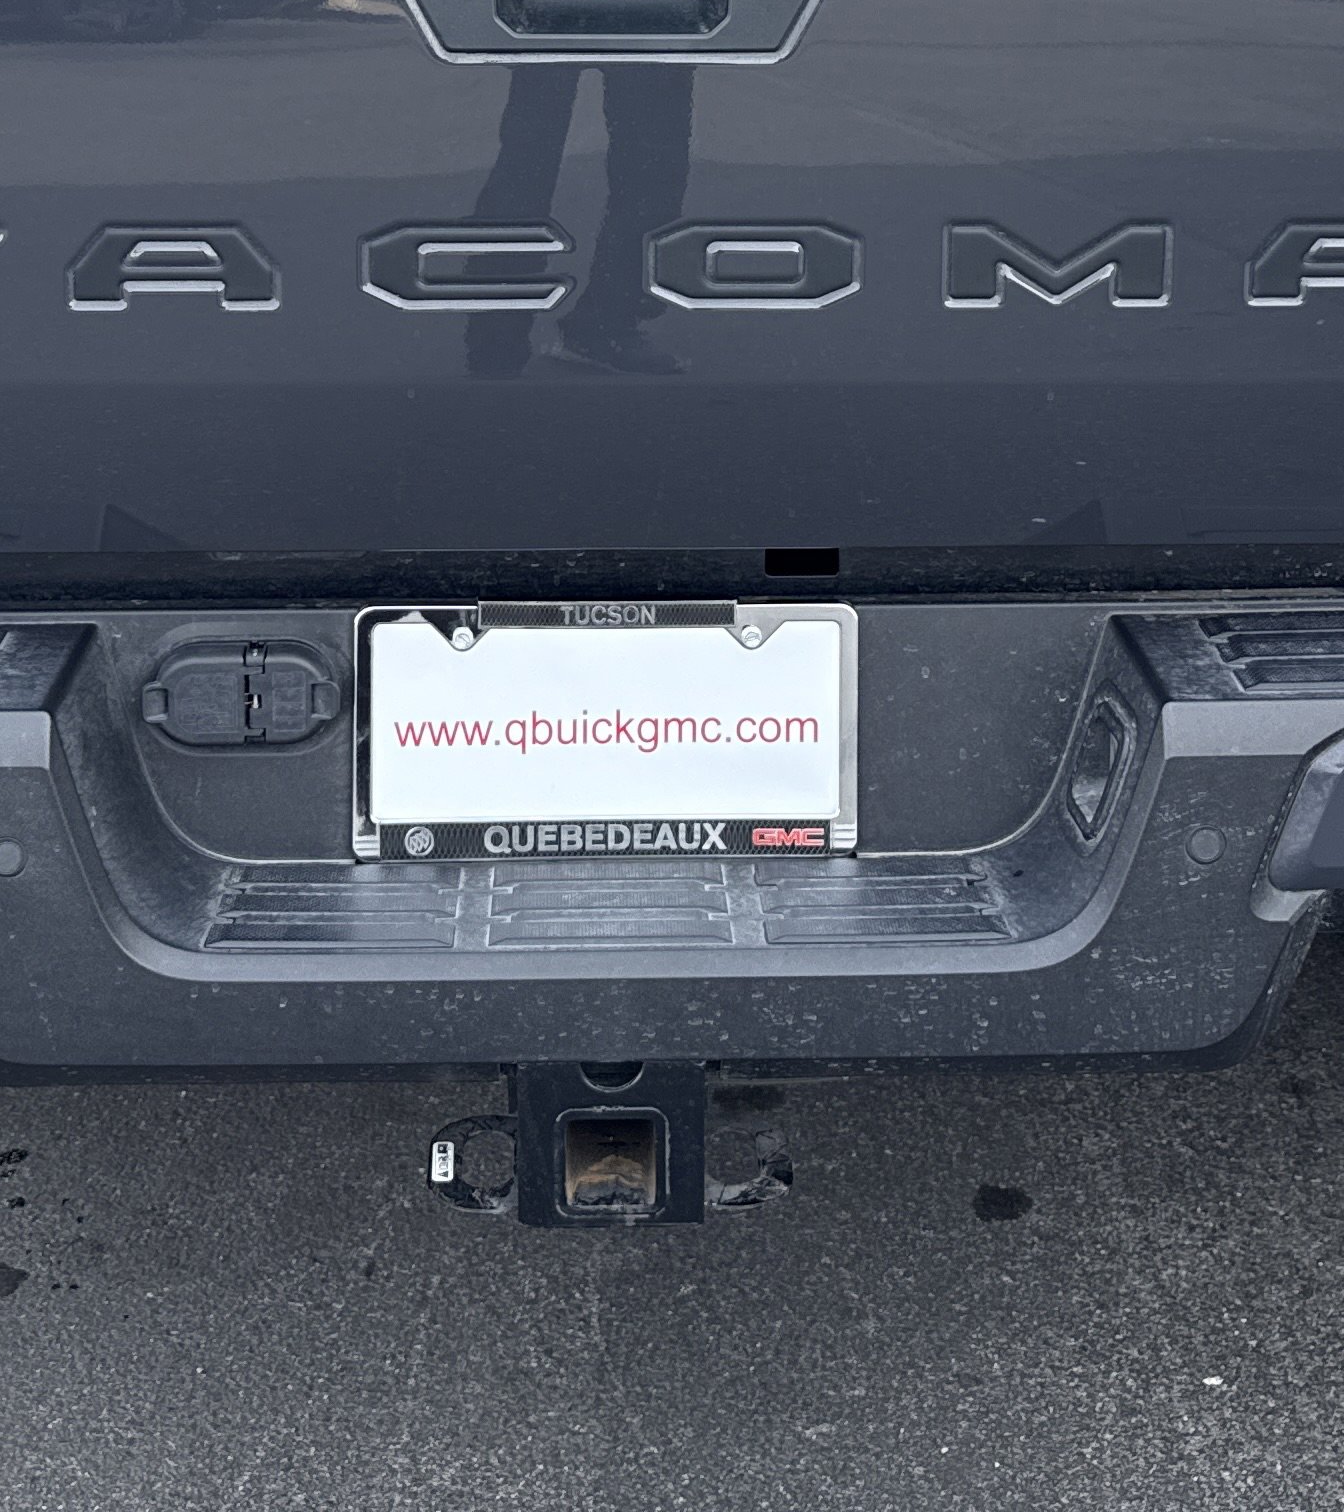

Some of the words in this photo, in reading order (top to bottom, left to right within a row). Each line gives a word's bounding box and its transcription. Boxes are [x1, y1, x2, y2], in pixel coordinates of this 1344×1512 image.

[559, 604, 657, 627] TUCSON
[393, 708, 820, 755] www.qbuickgmc.com
[483, 822, 728, 854] QUEBEDEAUX
[751, 828, 826, 848] GMC
